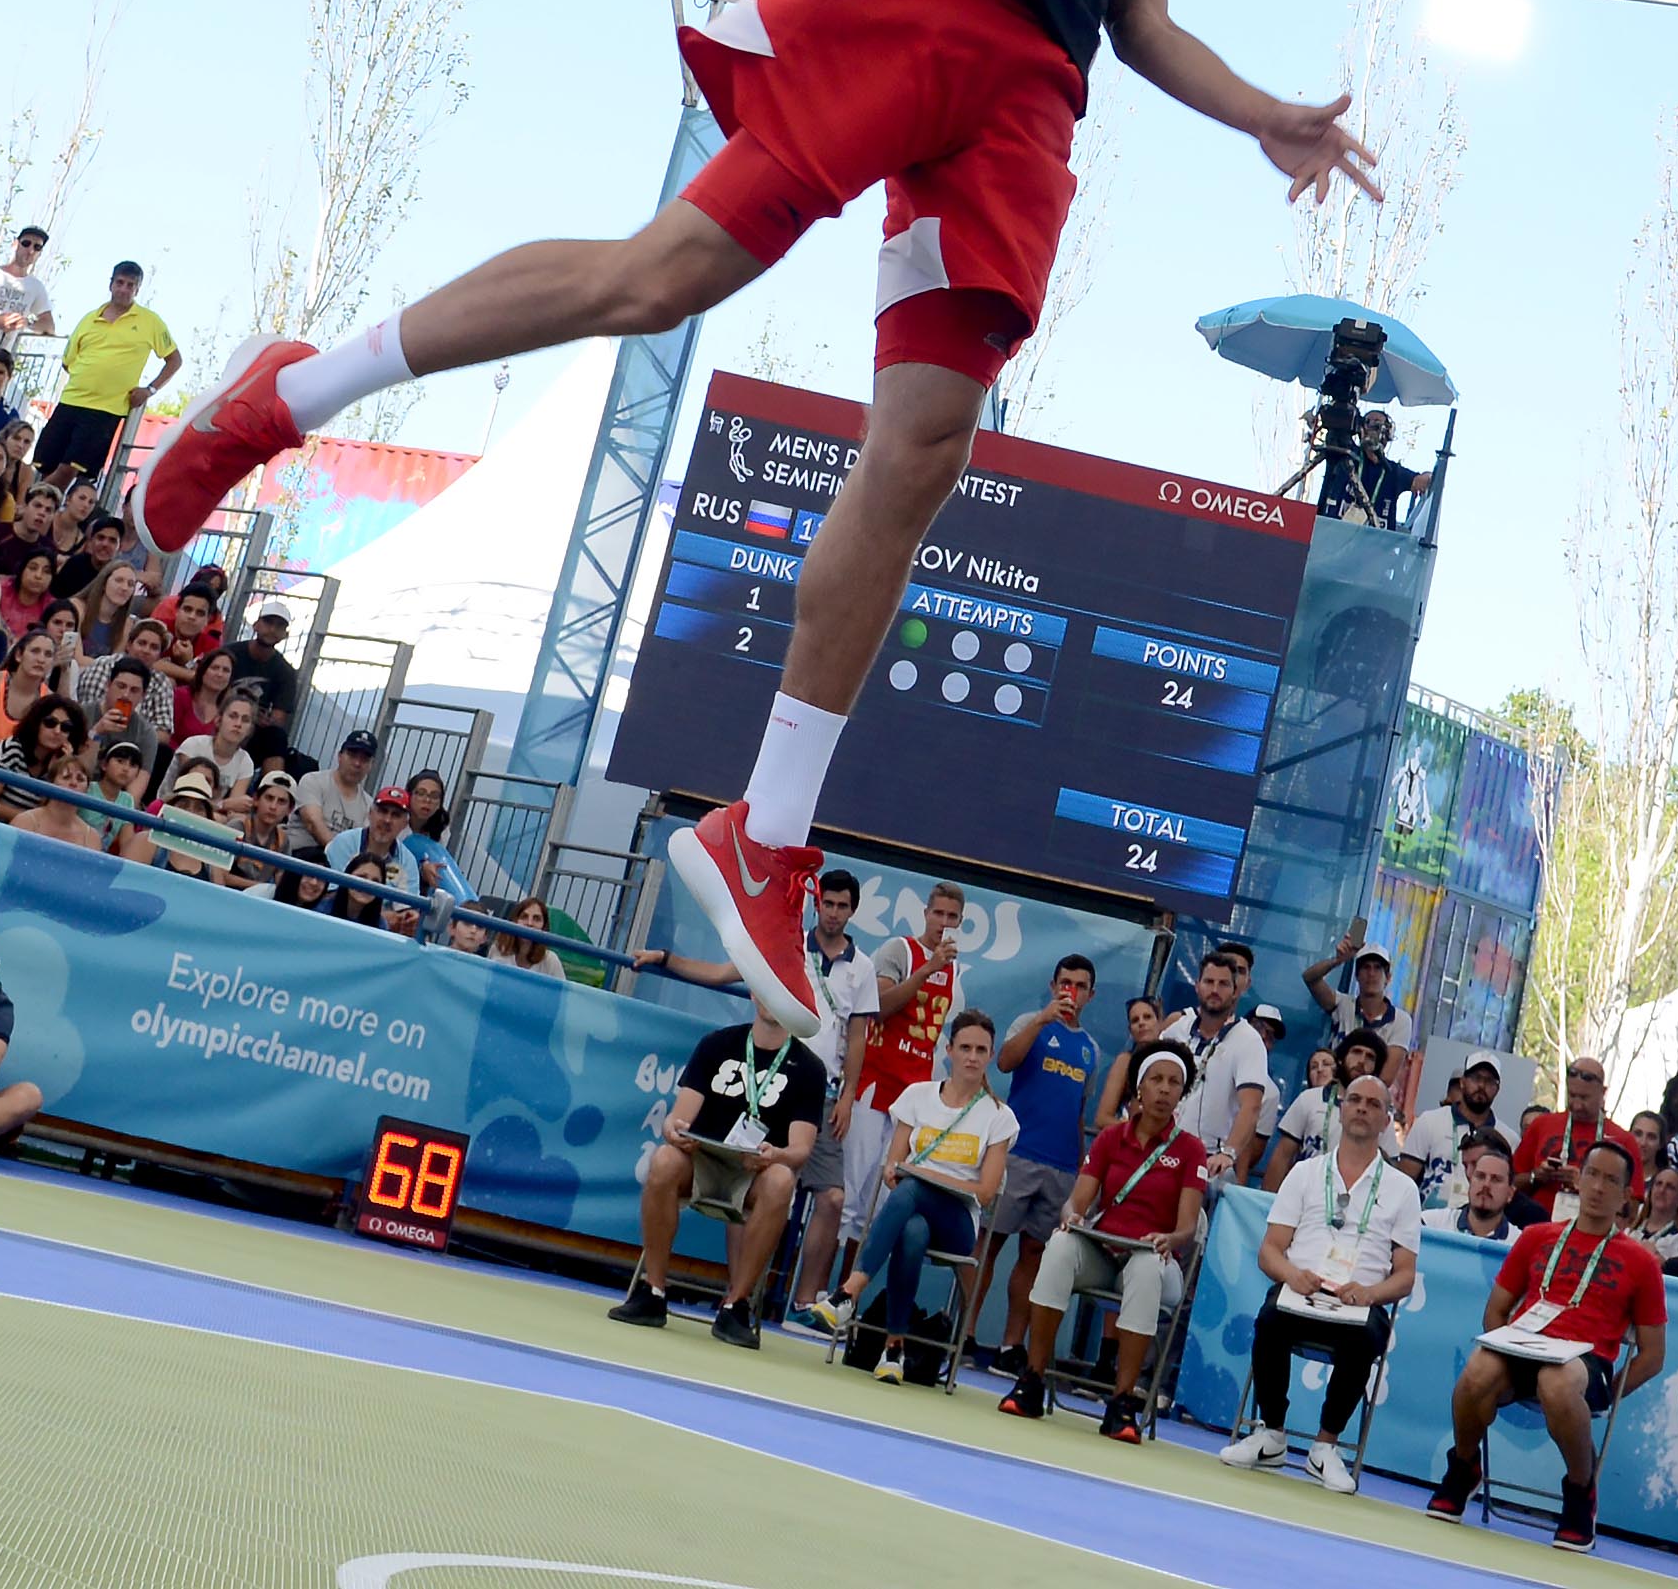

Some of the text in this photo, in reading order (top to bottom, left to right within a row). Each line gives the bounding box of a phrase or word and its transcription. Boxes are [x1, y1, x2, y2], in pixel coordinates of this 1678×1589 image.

[769, 433, 840, 466] MEN'S
[954, 475, 1023, 507] NTEST
[692, 492, 743, 525] RUS
[1190, 488, 1285, 529] OMEGA
[730, 548, 799, 582] DUNK
[912, 543, 1040, 593] OV Nikita
[746, 586, 761, 611] 1
[912, 591, 1034, 636] ATTEMPTS
[735, 626, 753, 652] 2
[1143, 642, 1227, 680] POINTS
[1161, 680, 1194, 709] 24
[1111, 803, 1188, 843] TOTAL
[1124, 843, 1159, 874] 24
[167, 951, 426, 1050] Explore more on
[131, 1002, 432, 1102] olympicchannel.com
[369, 1131, 462, 1219] 68
[386, 1221, 436, 1244] OMEGA
